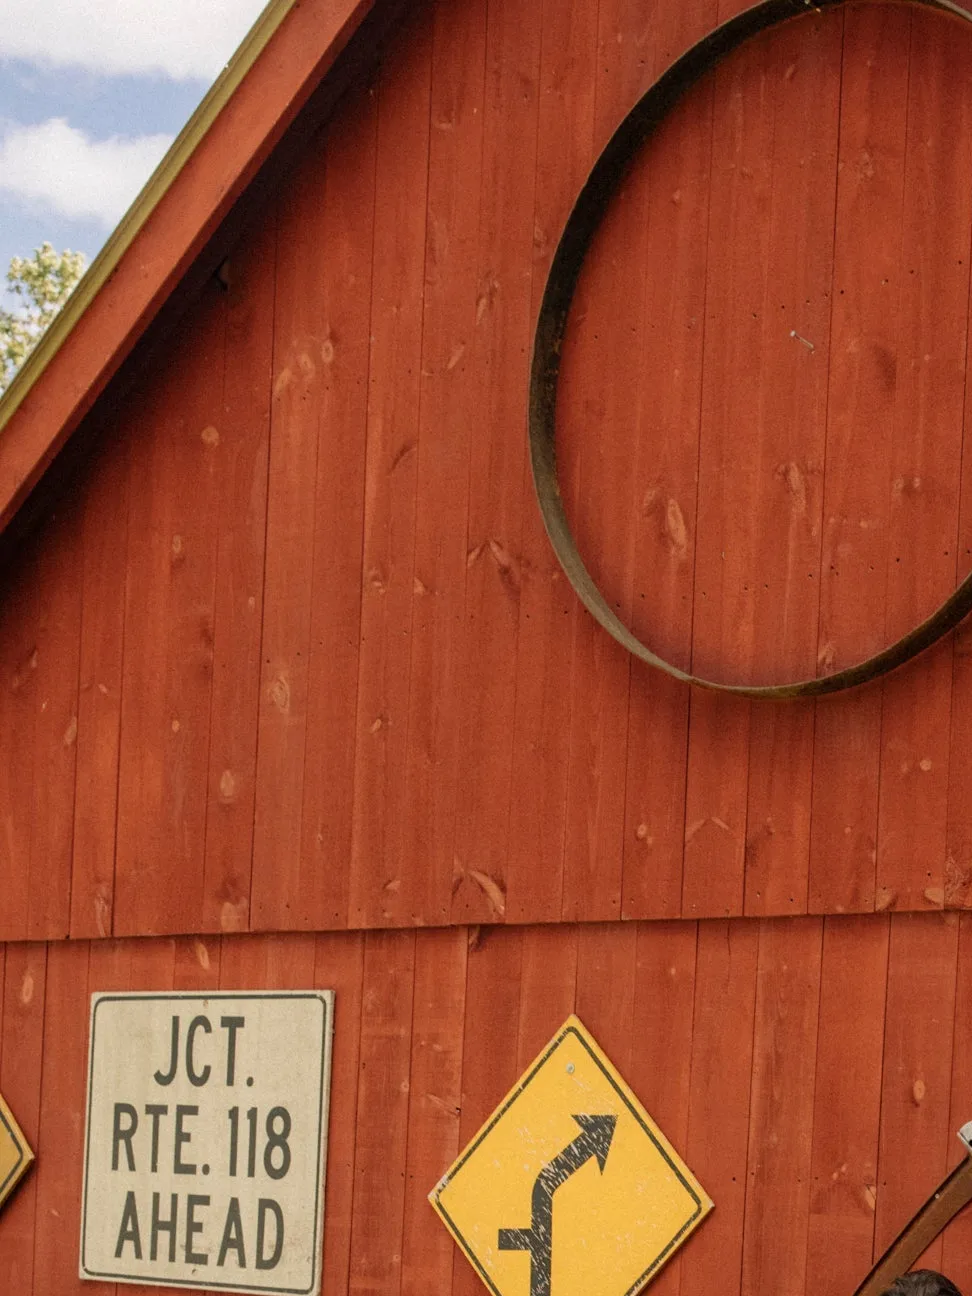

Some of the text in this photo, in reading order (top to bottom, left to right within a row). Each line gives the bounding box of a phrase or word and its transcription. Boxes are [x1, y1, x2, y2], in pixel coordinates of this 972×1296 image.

[153, 1015, 254, 1087] JCT.
[111, 1102, 292, 1181] RTE. 118
[114, 1190, 285, 1271] AHEAD
